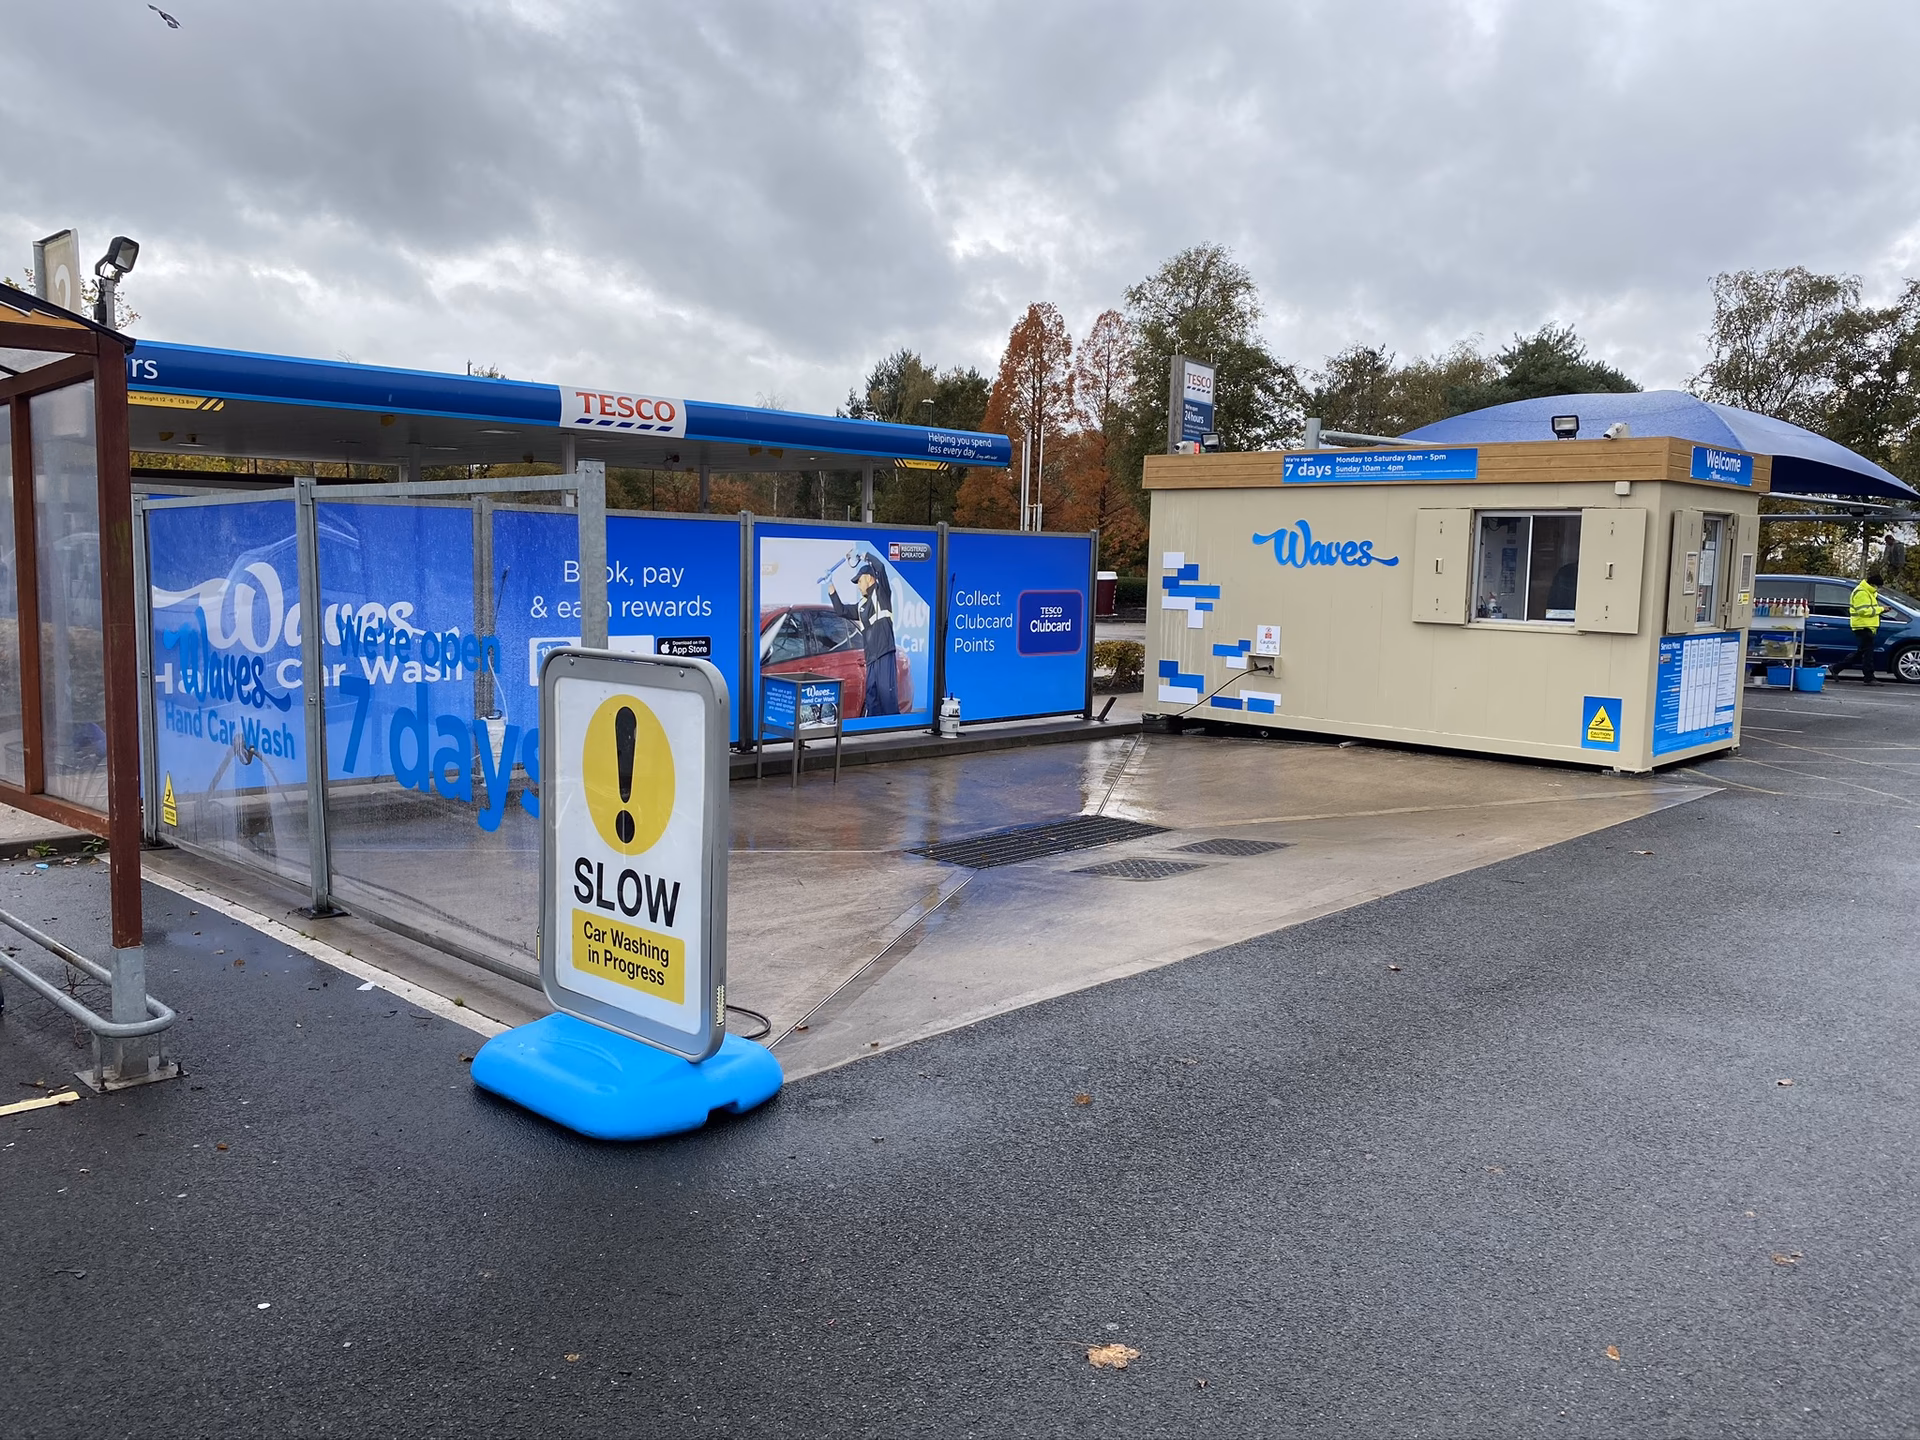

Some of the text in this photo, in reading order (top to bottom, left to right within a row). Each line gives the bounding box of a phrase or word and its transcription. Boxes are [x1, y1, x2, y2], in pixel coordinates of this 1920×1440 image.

[1187, 373, 1212, 389] TESCO
[575, 391, 676, 422] TESCO
[1184, 411, 1204, 424] 24 hours
[927, 432, 992, 448] Helping you spend
[927, 443, 942, 454] less
[943, 447, 962, 458] every
[963, 447, 976, 458] day
[1336, 456, 1363, 464] Monday
[1373, 454, 1406, 464] Saturday
[1429, 453, 1447, 462] 5pm
[1335, 465, 1361, 474] Sunday
[1387, 464, 1404, 473] 4pm
[1706, 449, 1741, 473] Welcome
[1285, 464, 1294, 477] 7
[1297, 463, 1332, 479] days
[1252, 519, 1399, 568] Waves
[564, 560, 684, 588] Bok, pay
[530, 595, 548, 618] &
[622, 595, 712, 617] rewards
[955, 590, 1001, 606] Collect
[1040, 606, 1063, 615] TESCO
[955, 613, 1013, 630] Clubcard
[1030, 618, 1072, 633] Clubcard
[336, 614, 502, 678] We're open
[672, 645, 708, 655] App Store
[901, 634, 925, 653] Car
[954, 637, 995, 653] Points
[163, 606, 291, 713] Waves
[801, 685, 835, 697] Waves
[165, 700, 295, 760] Hand Car Wash
[340, 675, 370, 774] 7
[574, 857, 681, 927] SLOW
[583, 921, 669, 968] Car Washing
[588, 944, 665, 986] in Progress
